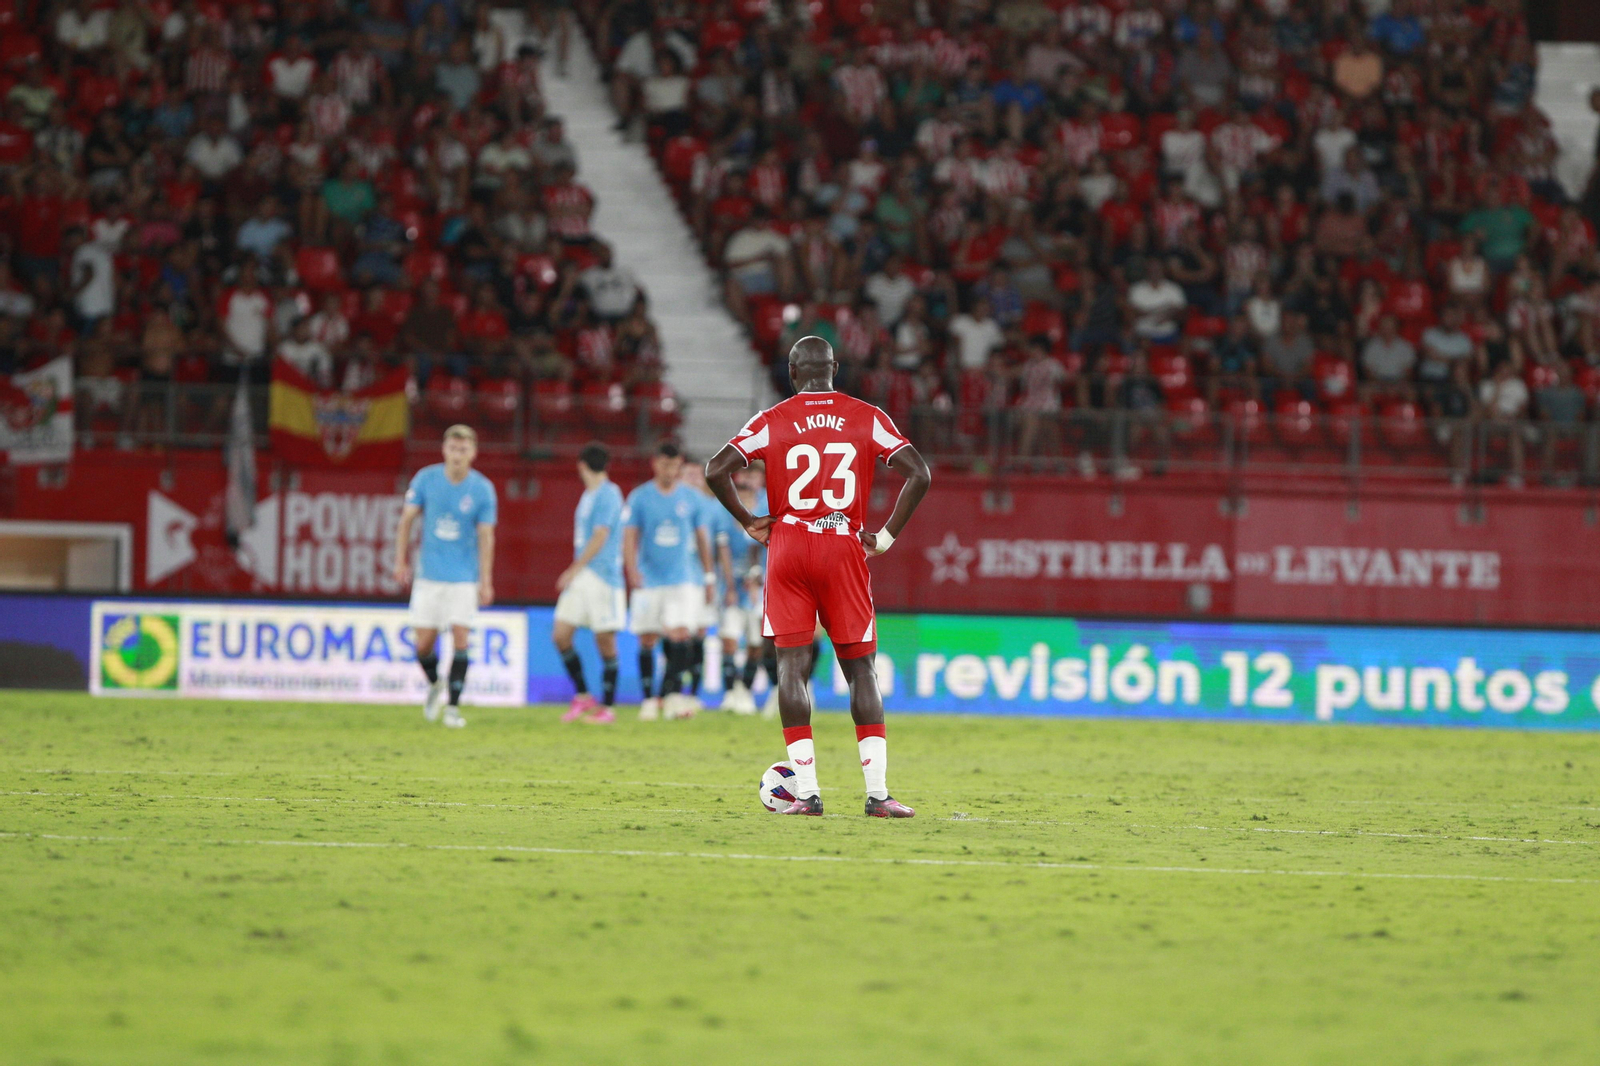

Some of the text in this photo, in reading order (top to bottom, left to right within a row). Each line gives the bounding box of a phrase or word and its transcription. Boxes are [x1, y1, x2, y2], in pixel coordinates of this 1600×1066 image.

[786, 442, 857, 510] 23
[284, 492, 421, 542] POWE
[284, 546, 421, 595] HORS
[979, 538, 1231, 582] ESTRELLA
[1273, 546, 1501, 589] LEVANTE
[192, 621, 509, 666] EUROMASR
[916, 642, 1201, 704] revisión
[1221, 651, 1295, 708] 12
[1315, 656, 1571, 721] puntos
